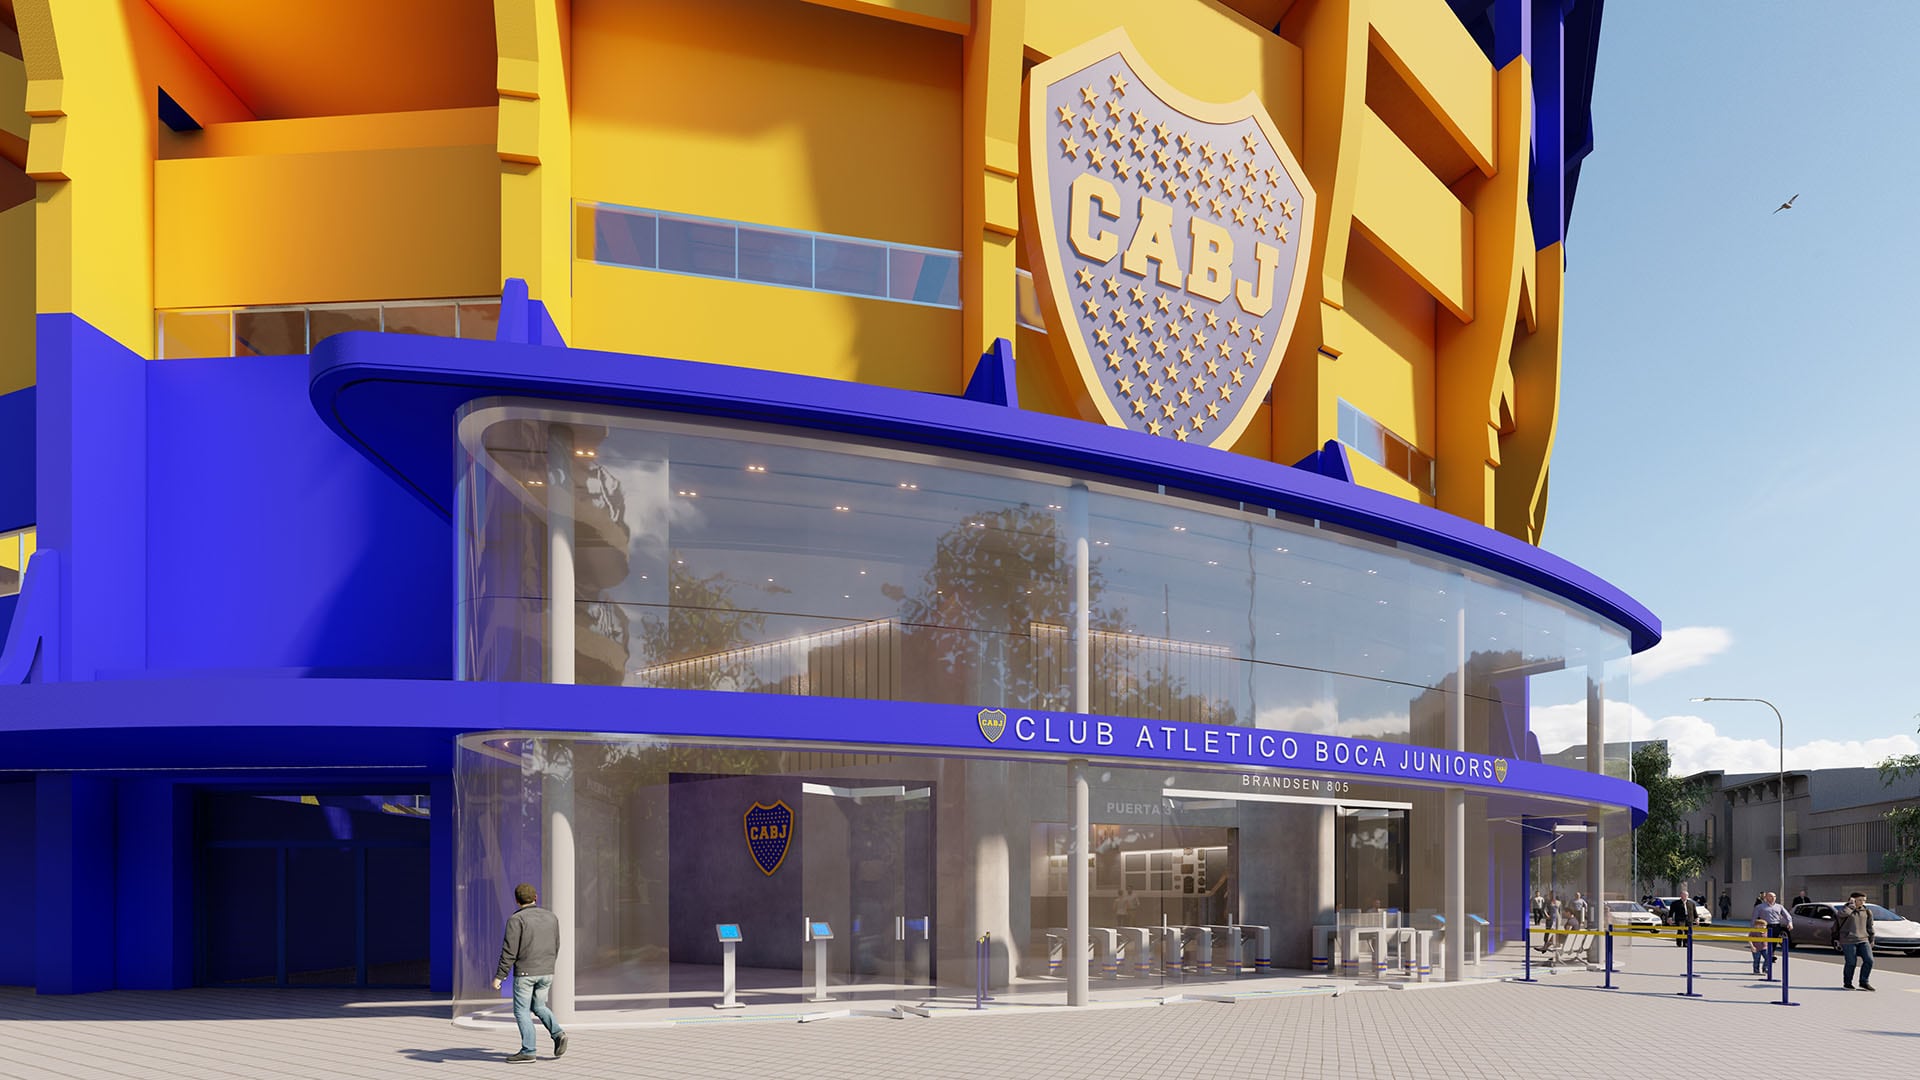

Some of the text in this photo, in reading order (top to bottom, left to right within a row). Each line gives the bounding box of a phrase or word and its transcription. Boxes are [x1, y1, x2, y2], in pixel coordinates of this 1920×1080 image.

[1069, 172, 1280, 317] CABJ
[1015, 716, 1492, 779] CLUB ATLETICO BOCA JUNIORS
[1242, 774, 1350, 793] BRANDSEN 805
[1106, 801, 1161, 816] PUERTA
[750, 824, 787, 841] CABJ
